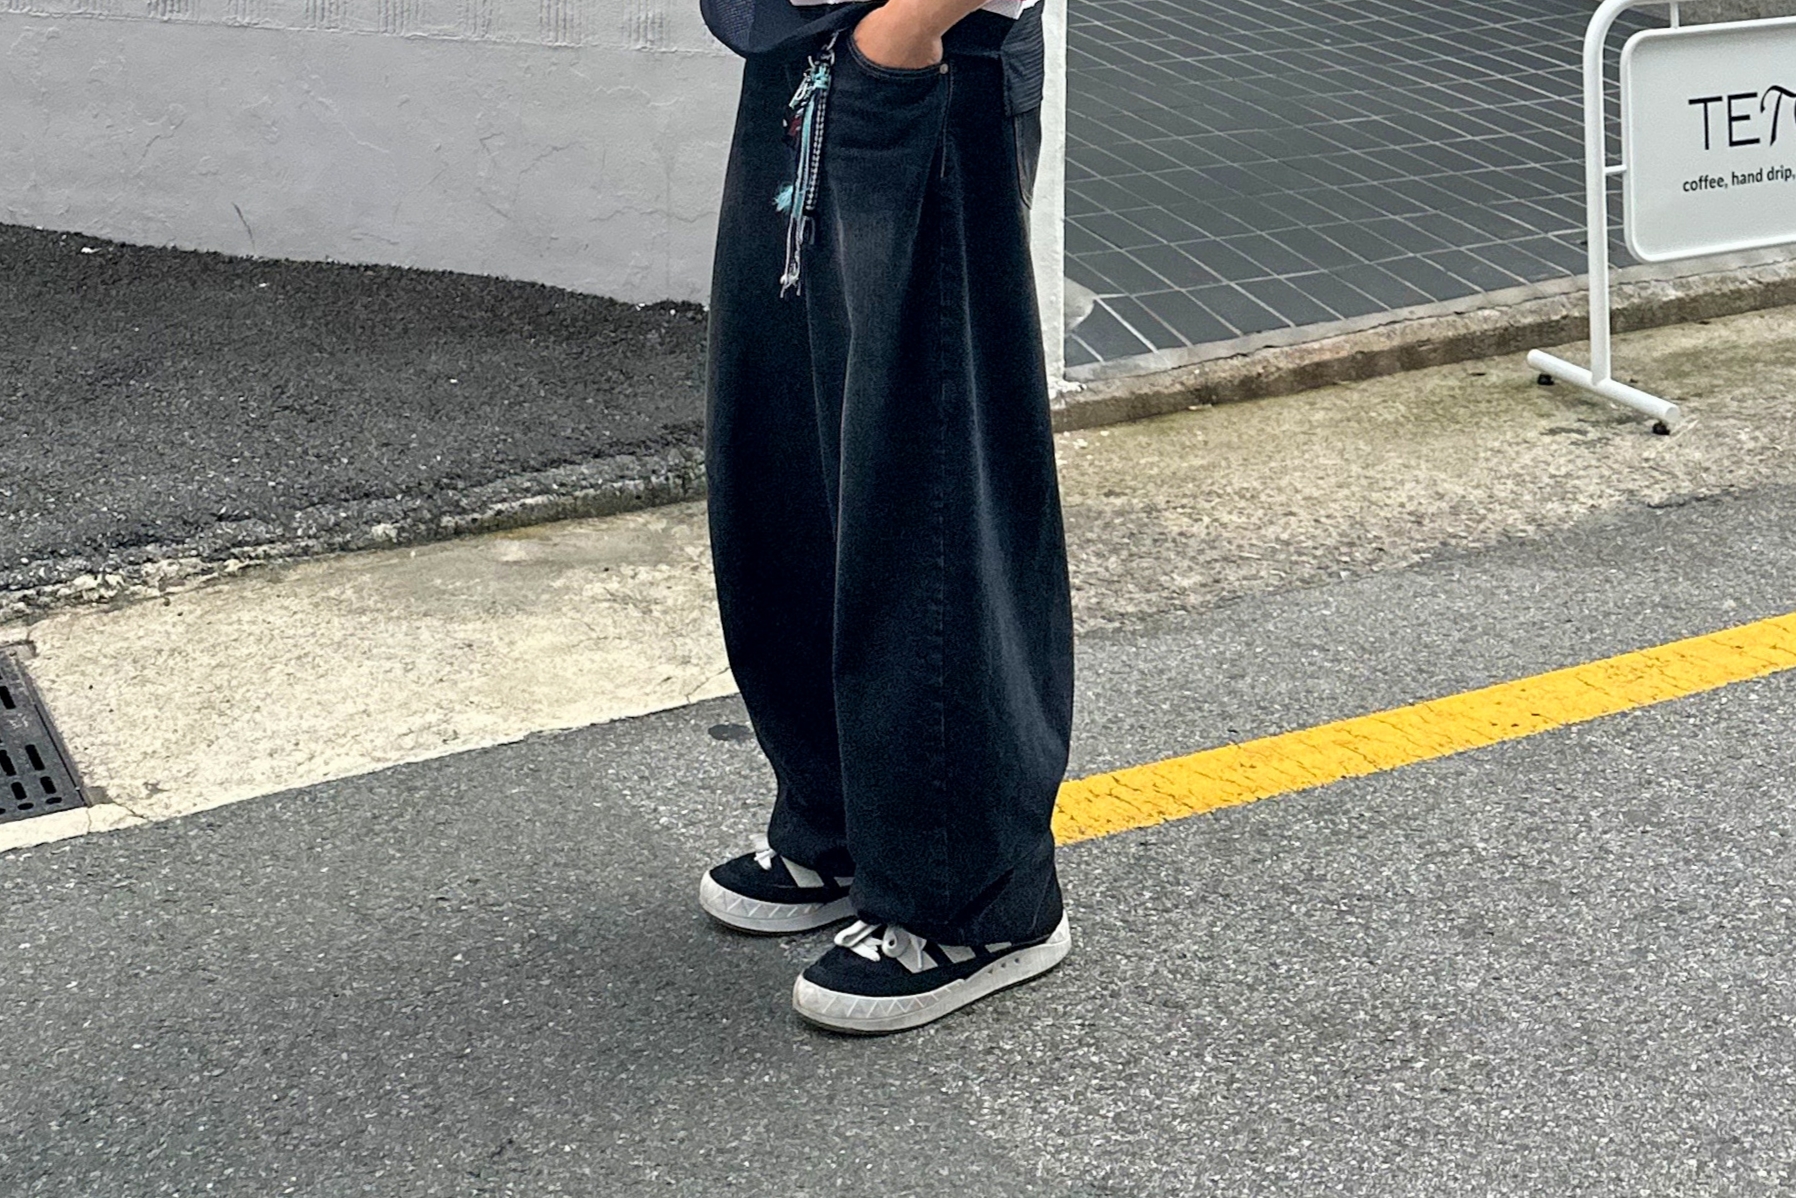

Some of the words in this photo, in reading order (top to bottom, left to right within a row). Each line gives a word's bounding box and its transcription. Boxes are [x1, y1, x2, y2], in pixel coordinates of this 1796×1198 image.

[1688, 85, 1796, 150] TET
[1682, 174, 1728, 192] coffee,
[1731, 167, 1763, 186] hand
[1766, 164, 1796, 183] drip,
